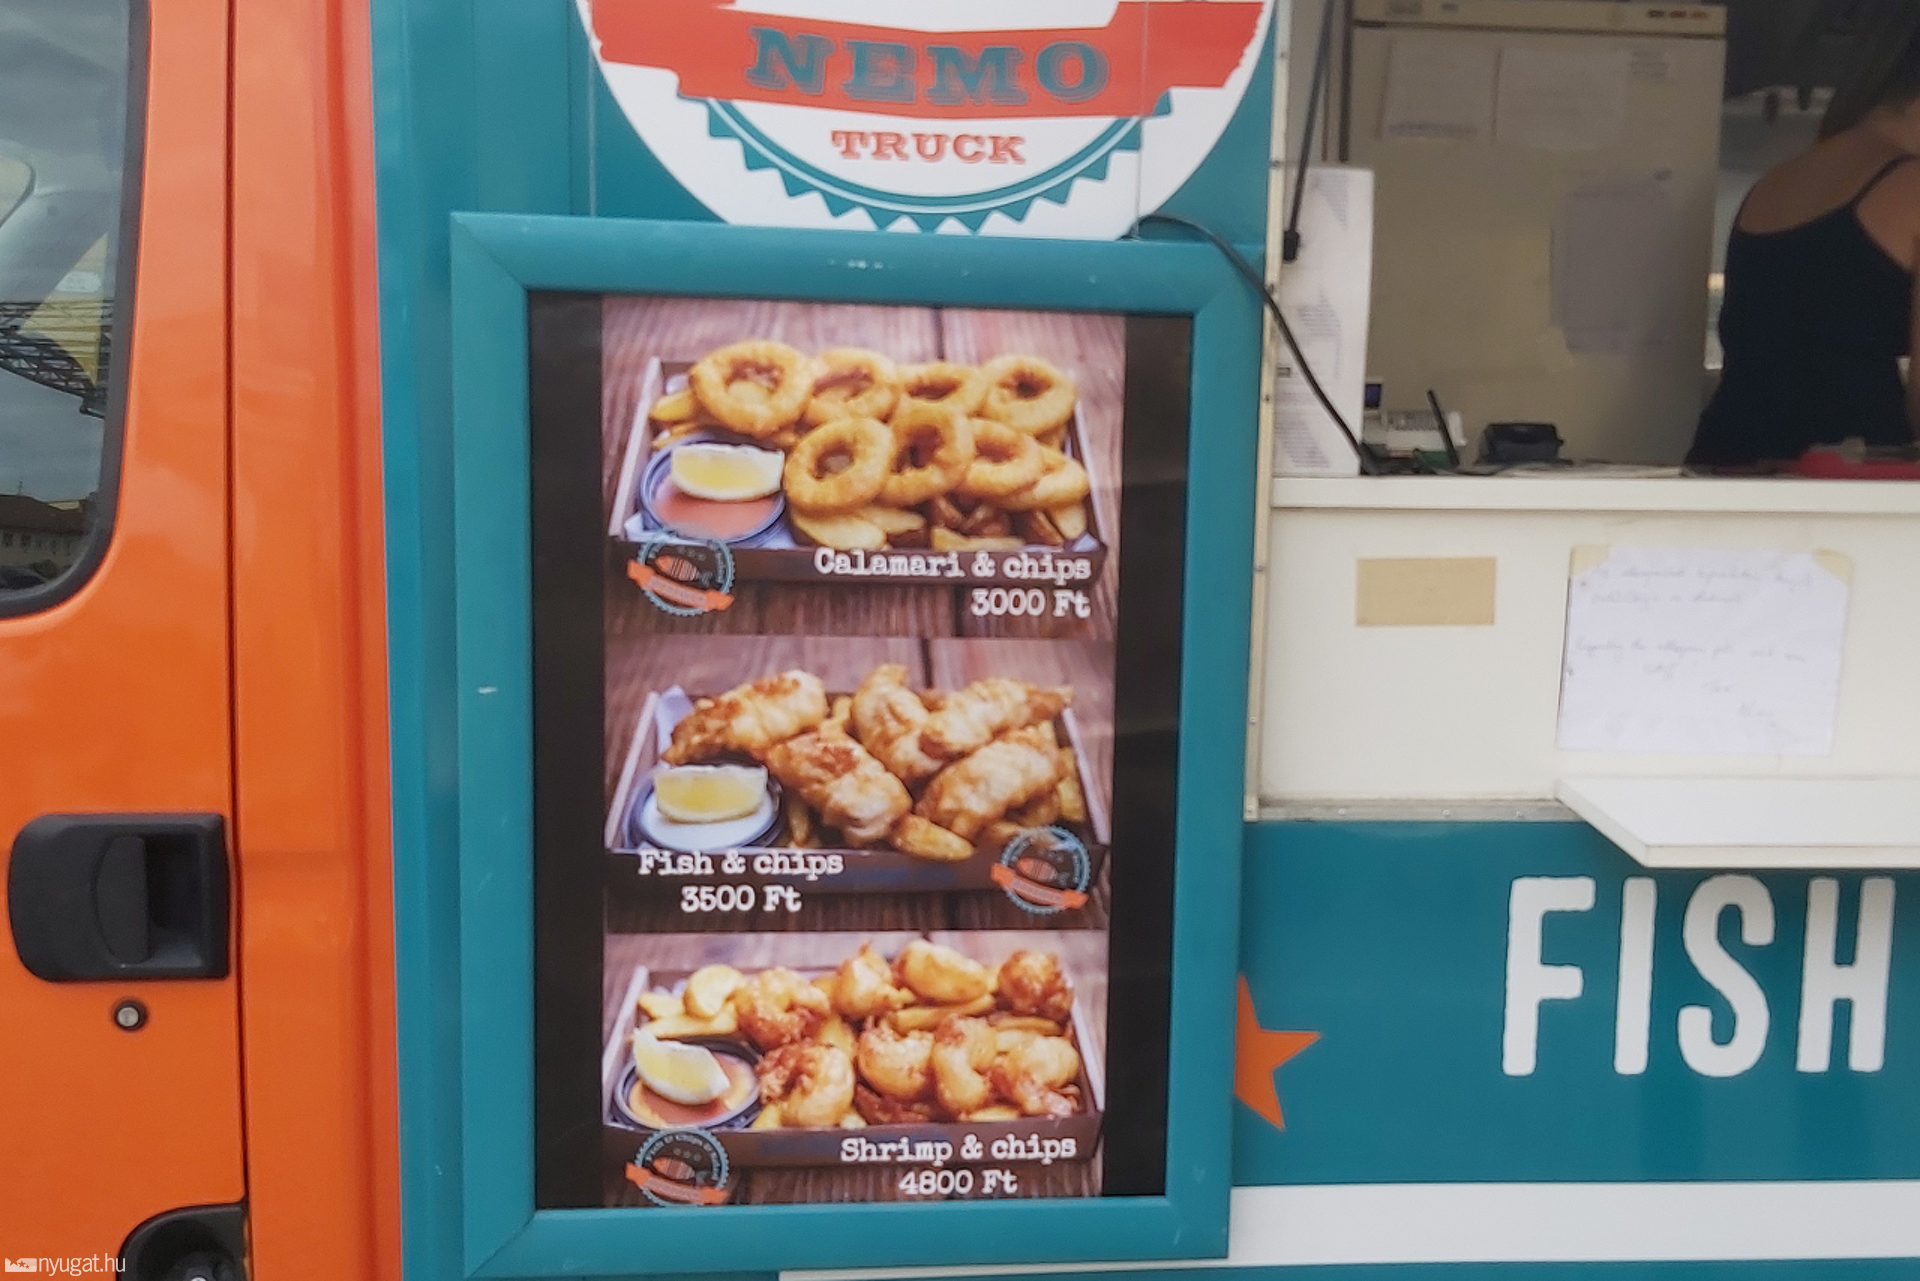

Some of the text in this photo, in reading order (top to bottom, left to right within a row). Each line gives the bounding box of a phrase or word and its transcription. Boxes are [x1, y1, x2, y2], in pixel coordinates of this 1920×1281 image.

[745, 27, 1109, 106] NEMO
[831, 130, 1026, 165] TRUCK
[814, 547, 1092, 586] Calamari & chips
[970, 589, 1092, 618] 3000 Ft
[637, 847, 844, 881] Fish & chips
[680, 884, 802, 913] 3500 Ft
[1502, 873, 1897, 1077] FISH
[840, 1134, 1077, 1166] Shrimp & chips
[898, 1169, 1019, 1195] 4800 Ft
